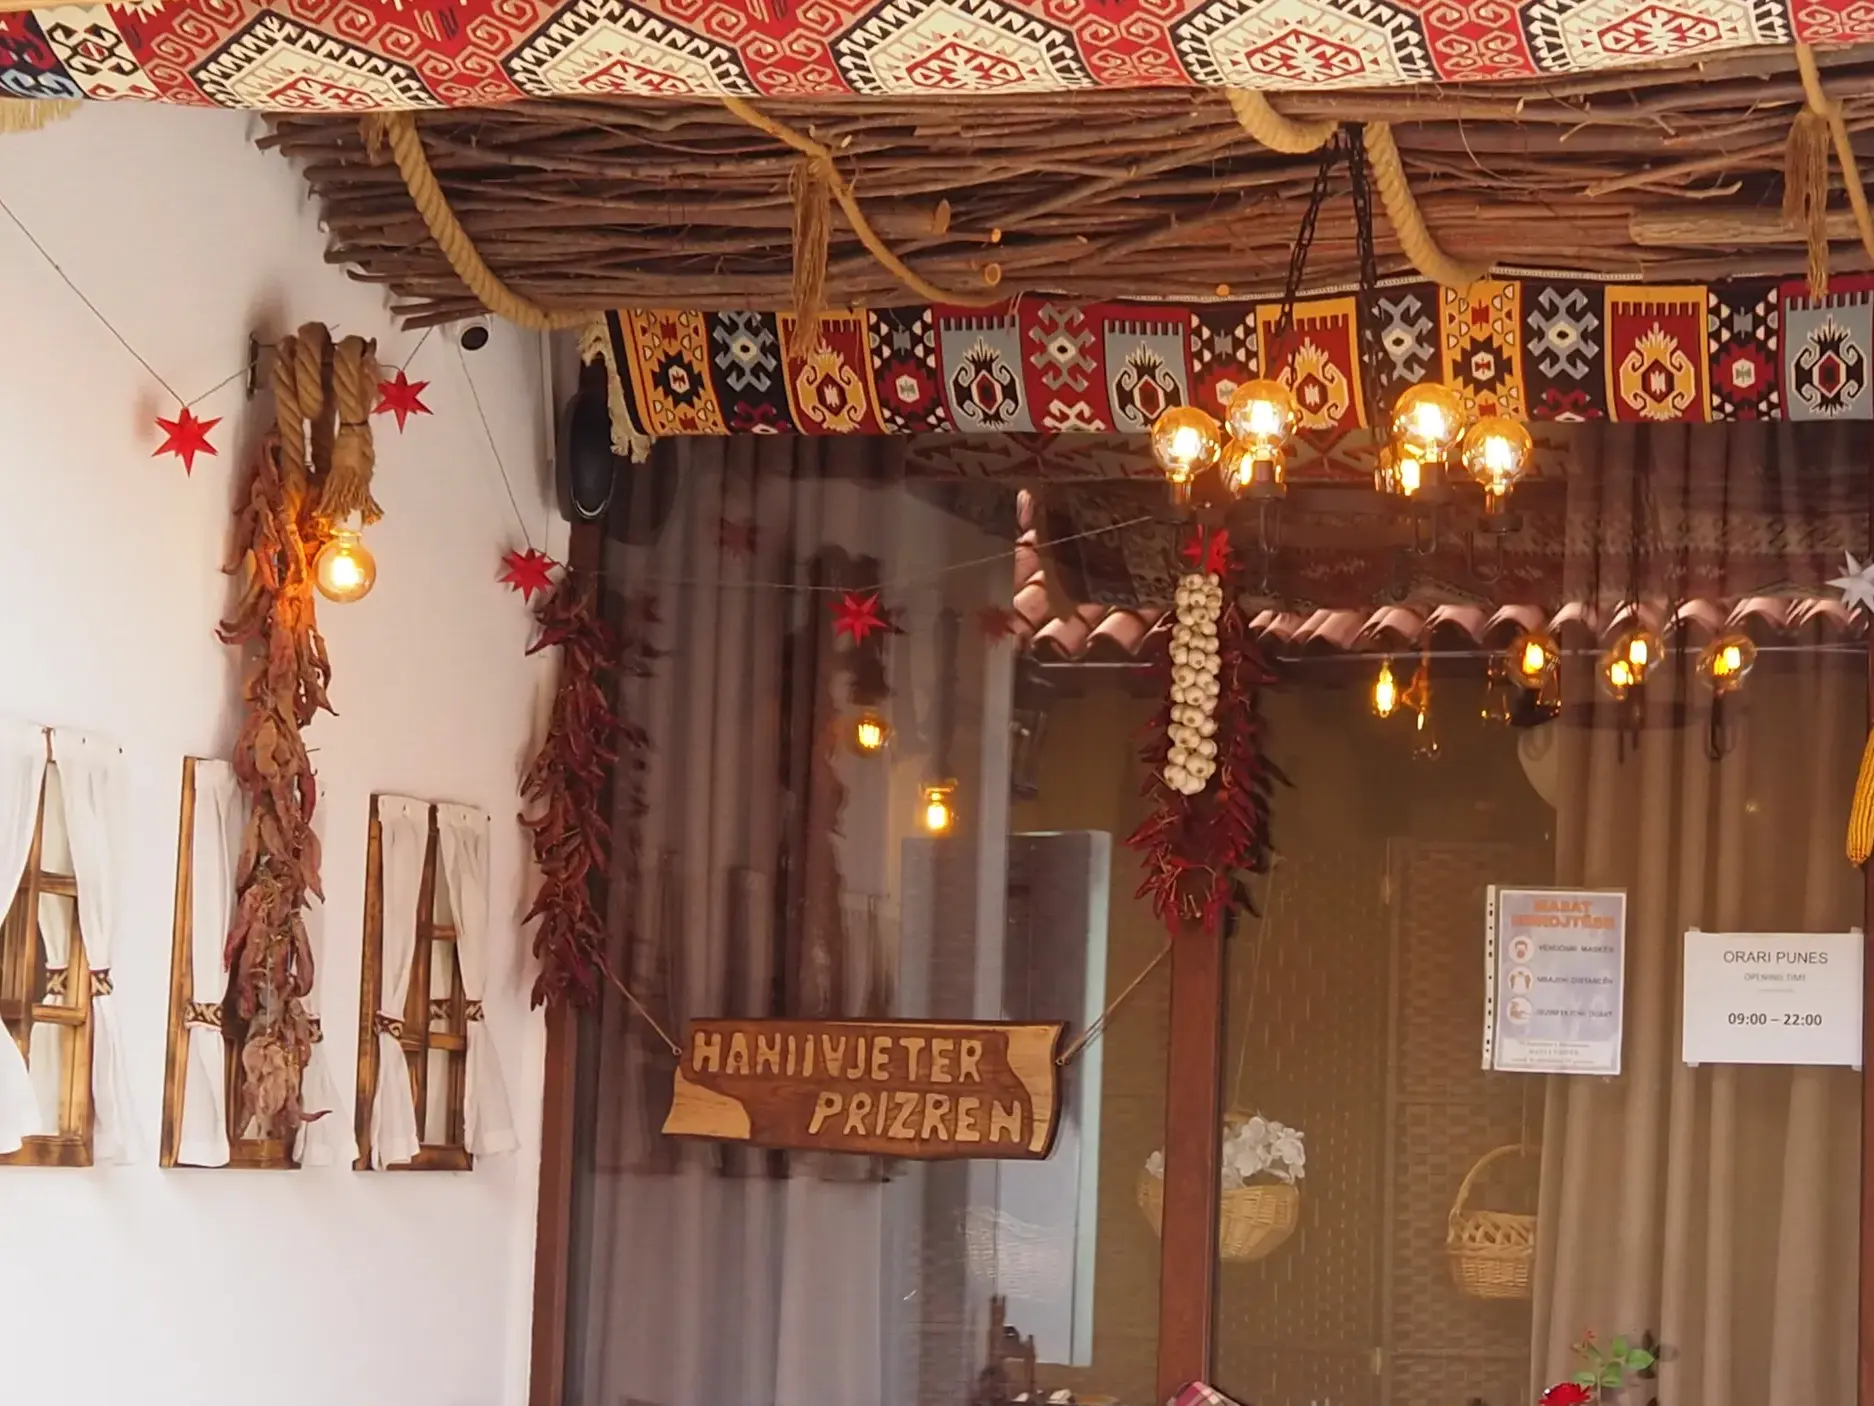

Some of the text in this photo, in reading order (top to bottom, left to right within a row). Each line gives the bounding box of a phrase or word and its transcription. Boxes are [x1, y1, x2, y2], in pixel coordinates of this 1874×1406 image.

[1723, 950, 1829, 964] ORARI PUNES
[1728, 1012, 1767, 1025] 09:00
[1783, 1013, 1822, 1026] 22:00
[808, 1091, 1021, 1142] PRIZREN
